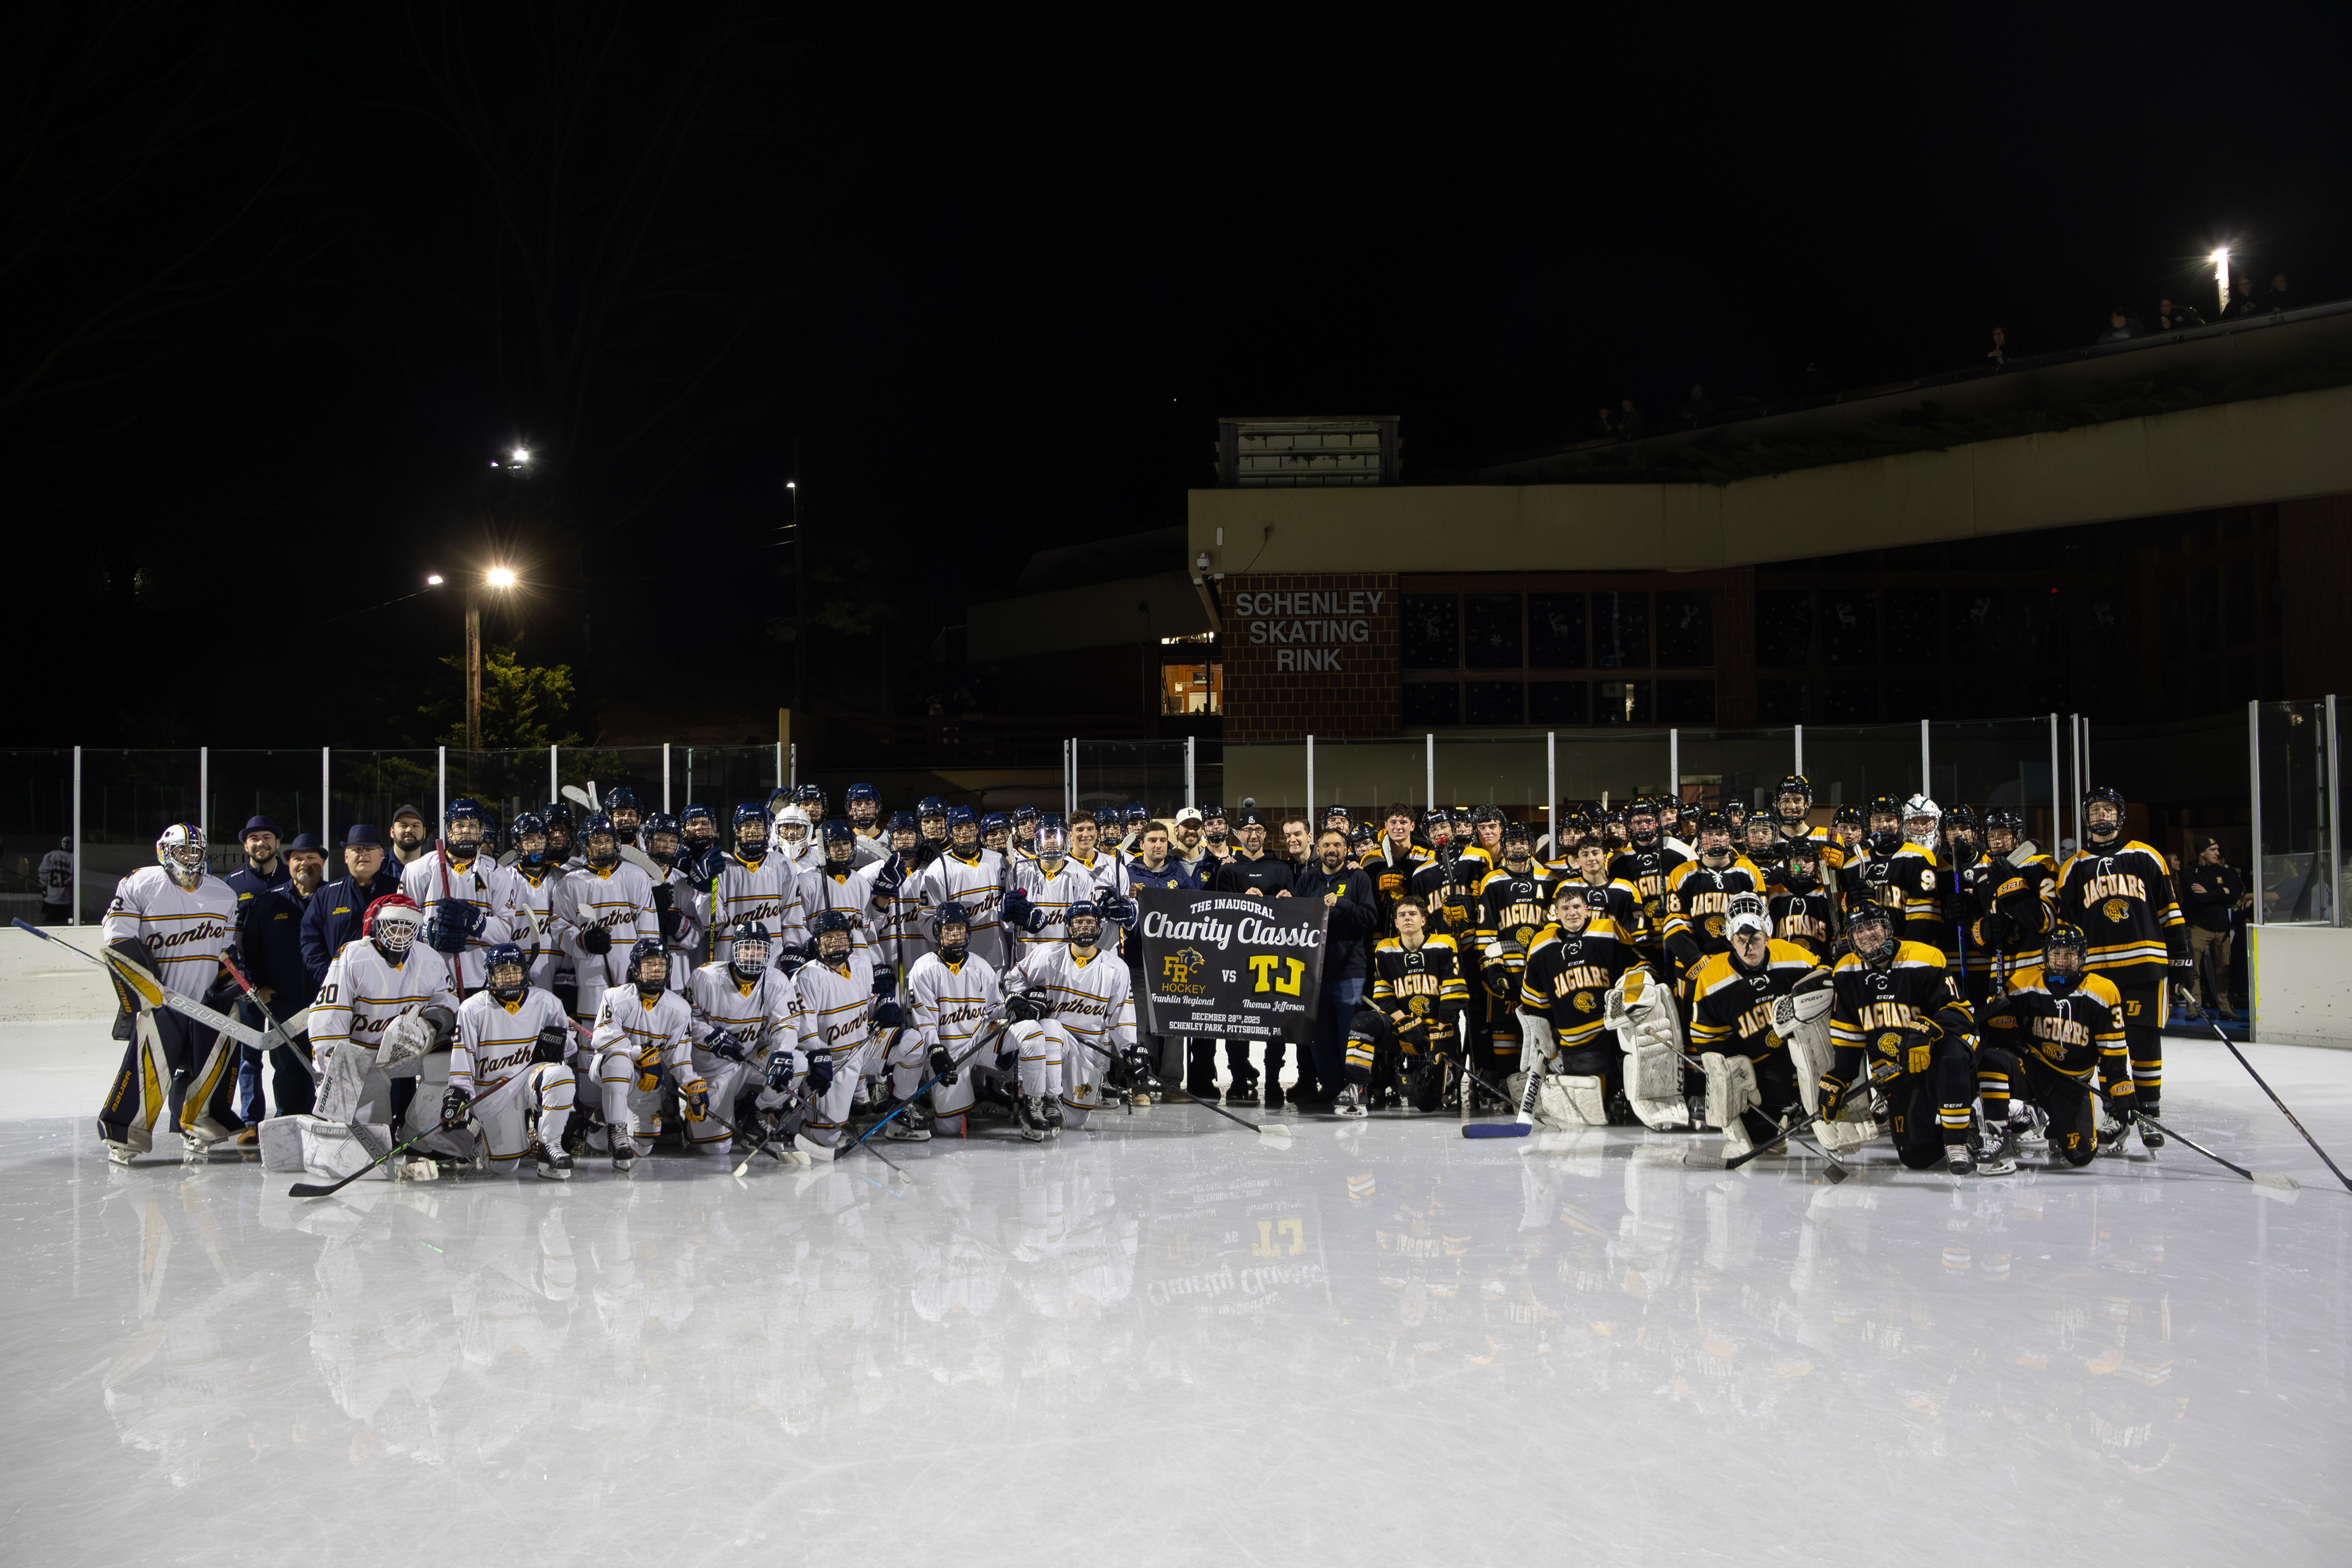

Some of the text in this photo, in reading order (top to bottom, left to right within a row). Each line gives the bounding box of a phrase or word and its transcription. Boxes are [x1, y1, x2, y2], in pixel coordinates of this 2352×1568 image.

[1236, 592, 1383, 616] SCHENLEY
[1250, 619, 1368, 643] SKATING
[1277, 649, 1342, 671] RINK
[1536, 884, 1544, 899] A
[1920, 869, 1936, 891] 9
[2082, 872, 2146, 910] JAGUARS
[919, 890, 928, 907] 5
[1190, 899, 1275, 920] THE INAUGURAL
[1691, 892, 1736, 918] JAGUA
[146, 920, 226, 950] Panthe
[1144, 911, 1320, 950] Charity Classic
[1776, 913, 1827, 943] AGUARS
[780, 954, 806, 963] BAUE
[1163, 956, 1188, 982] FR
[1687, 956, 1710, 979] BAUE
[1162, 982, 1206, 993] HOCKEY
[1222, 970, 1236, 982] VS
[1250, 956, 1305, 997] TJ
[1393, 974, 1439, 1000] JAGUAR
[1553, 965, 1610, 999] JAGUARS
[315, 984, 339, 1005] 30
[1152, 993, 1215, 1006] Franklin Regional
[1242, 999, 1305, 1012] Thomas Jefferson
[1755, 994, 1775, 1003] CCM
[169, 995, 241, 1035] BAUER
[938, 1003, 987, 1027] anthers
[1045, 998, 1106, 1016] anthers
[1191, 1012, 1226, 1022] DECEMBER
[2111, 1006, 2125, 1030] 3
[2125, 999, 2143, 1017] TJ
[1169, 1021, 1203, 1030] SCHENLEY
[1204, 1023, 1225, 1033] PARK,
[1227, 1024, 1271, 1036] PITTSBURGH,
[1397, 1016, 1422, 1034] BAUE
[1738, 1002, 1774, 1039] JAGU
[2032, 1015, 2090, 1047] JAGUARS
[478, 1045, 535, 1079] Panth
[774, 1057, 794, 1065] CC
[111, 1069, 132, 1112] BAUER
[318, 1076, 334, 1114] BAUER
[1522, 1071, 1542, 1114] VAUGHN
[1894, 1115, 1904, 1133] 17
